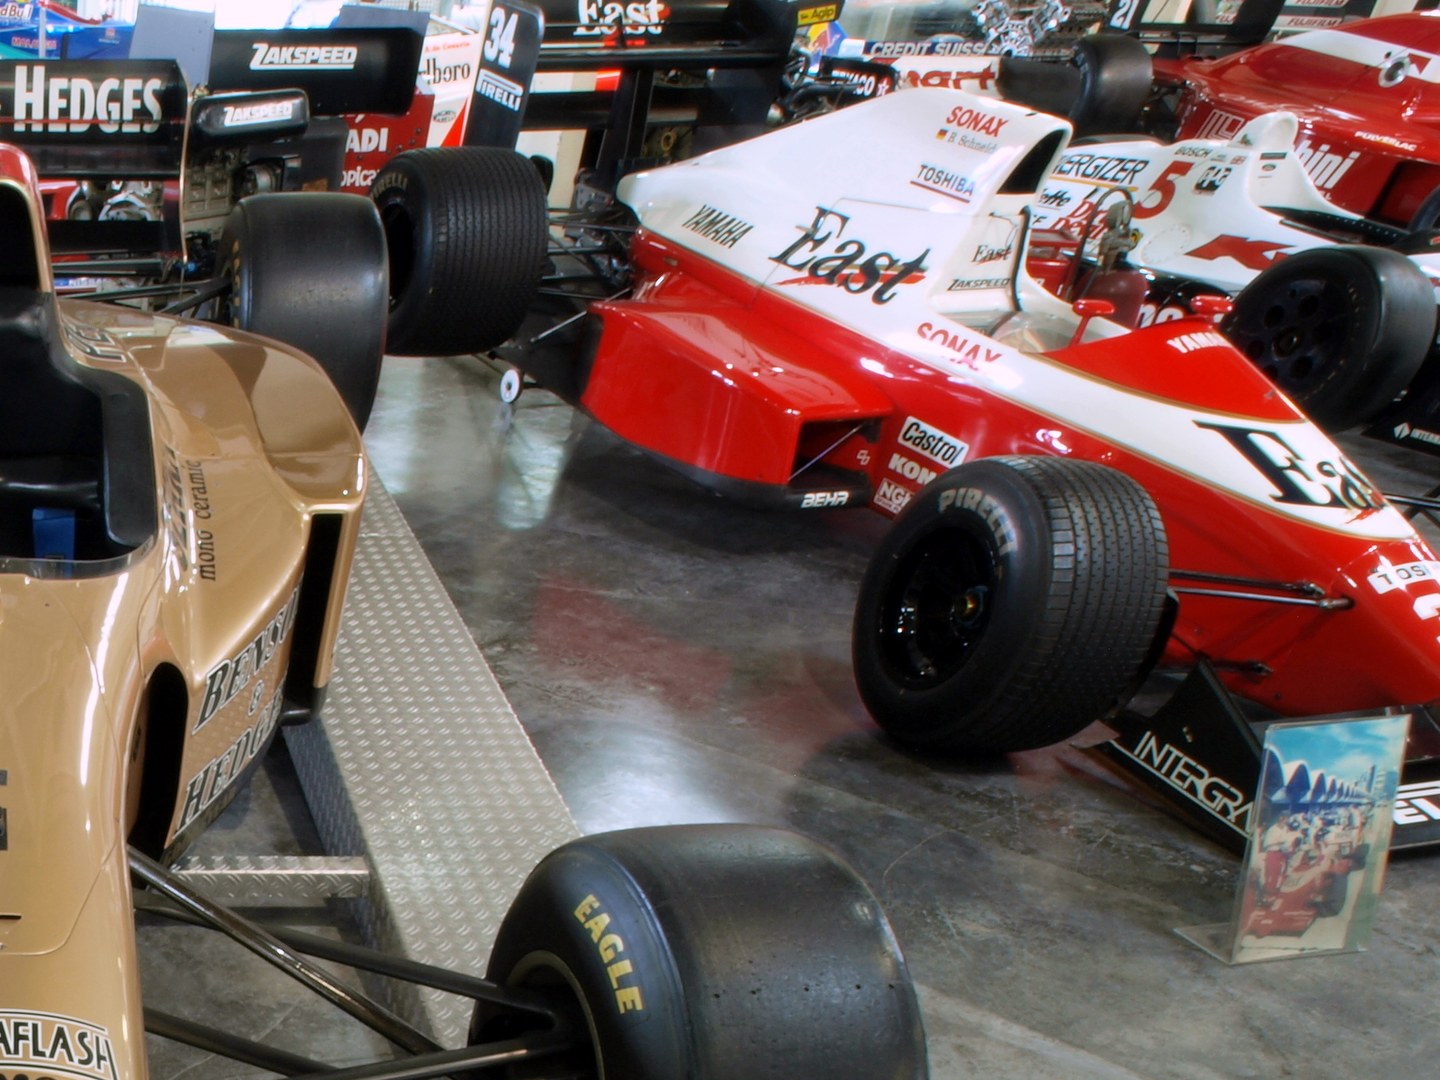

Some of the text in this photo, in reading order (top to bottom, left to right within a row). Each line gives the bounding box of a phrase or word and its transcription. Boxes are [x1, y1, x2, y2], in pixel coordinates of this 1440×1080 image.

[573, 0, 666, 36] East
[812, 5, 836, 20] Agip
[484, 6, 519, 70] 34
[870, 42, 932, 56] CREDIT
[249, 43, 358, 71] ZAKSPEED
[13, 65, 162, 133] HEDGES
[476, 68, 524, 112] PIRELLI
[223, 101, 293, 127] ZAKSPEED
[946, 106, 1008, 137] SONAX
[917, 164, 976, 196] TOSHIBA
[1132, 160, 1196, 220] 5
[682, 204, 754, 249] YAMAHA
[769, 206, 930, 303] East
[971, 244, 1013, 265] East
[947, 278, 1011, 291] ZAKSPEED
[902, 421, 966, 466] Castrol
[801, 491, 850, 508] BEHR
[186, 459, 217, 582] mono ceramic
[573, 894, 644, 1015] EAGLE
